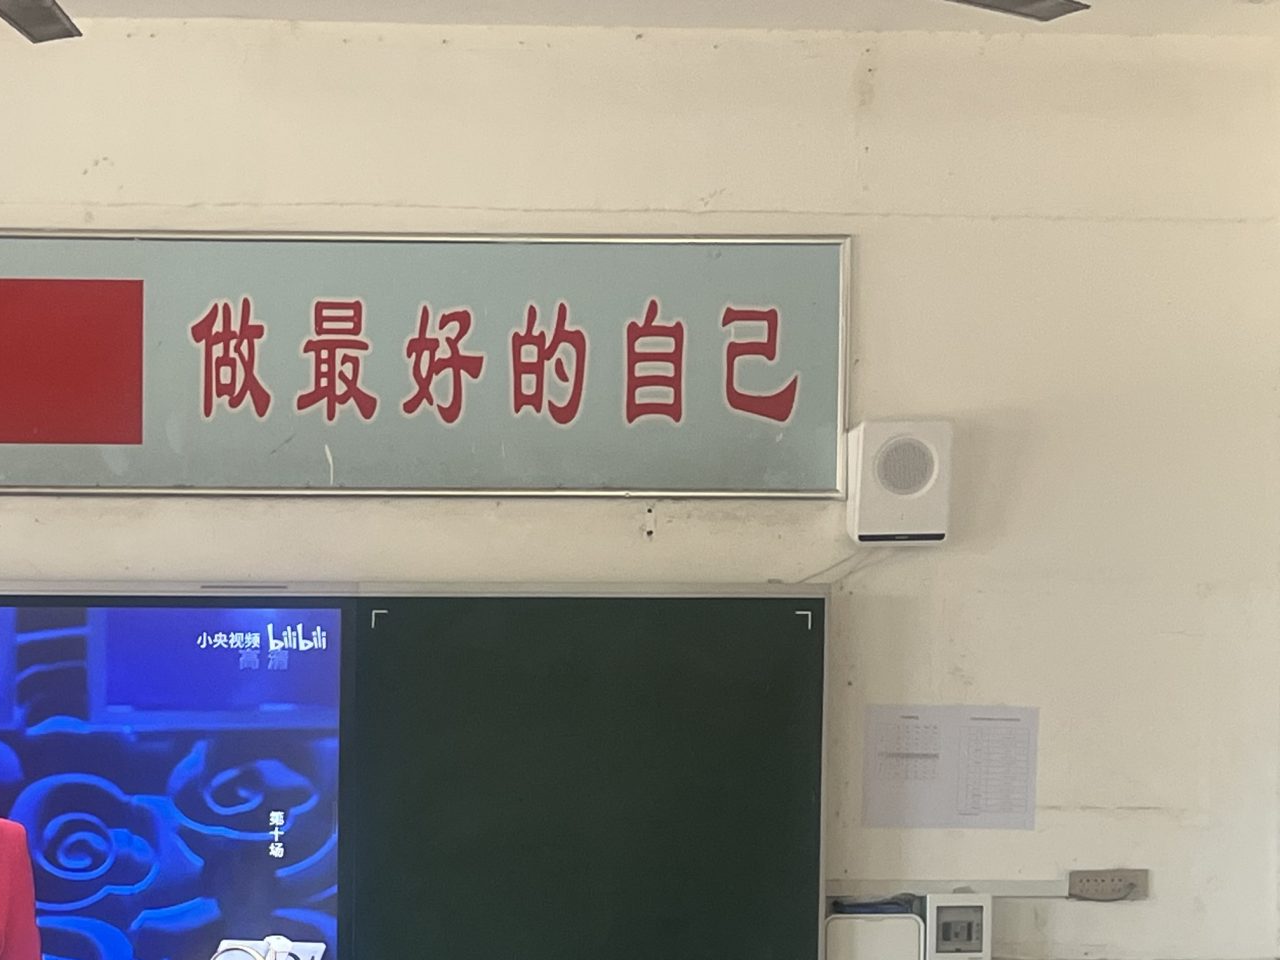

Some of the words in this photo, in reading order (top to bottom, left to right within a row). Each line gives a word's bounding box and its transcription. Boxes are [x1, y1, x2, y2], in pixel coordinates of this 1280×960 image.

[191, 297, 799, 424] 做最好的自己
[196, 632, 260, 649] 小央视频
[267, 623, 327, 651] bilibili
[268, 810, 285, 858] 第十场
